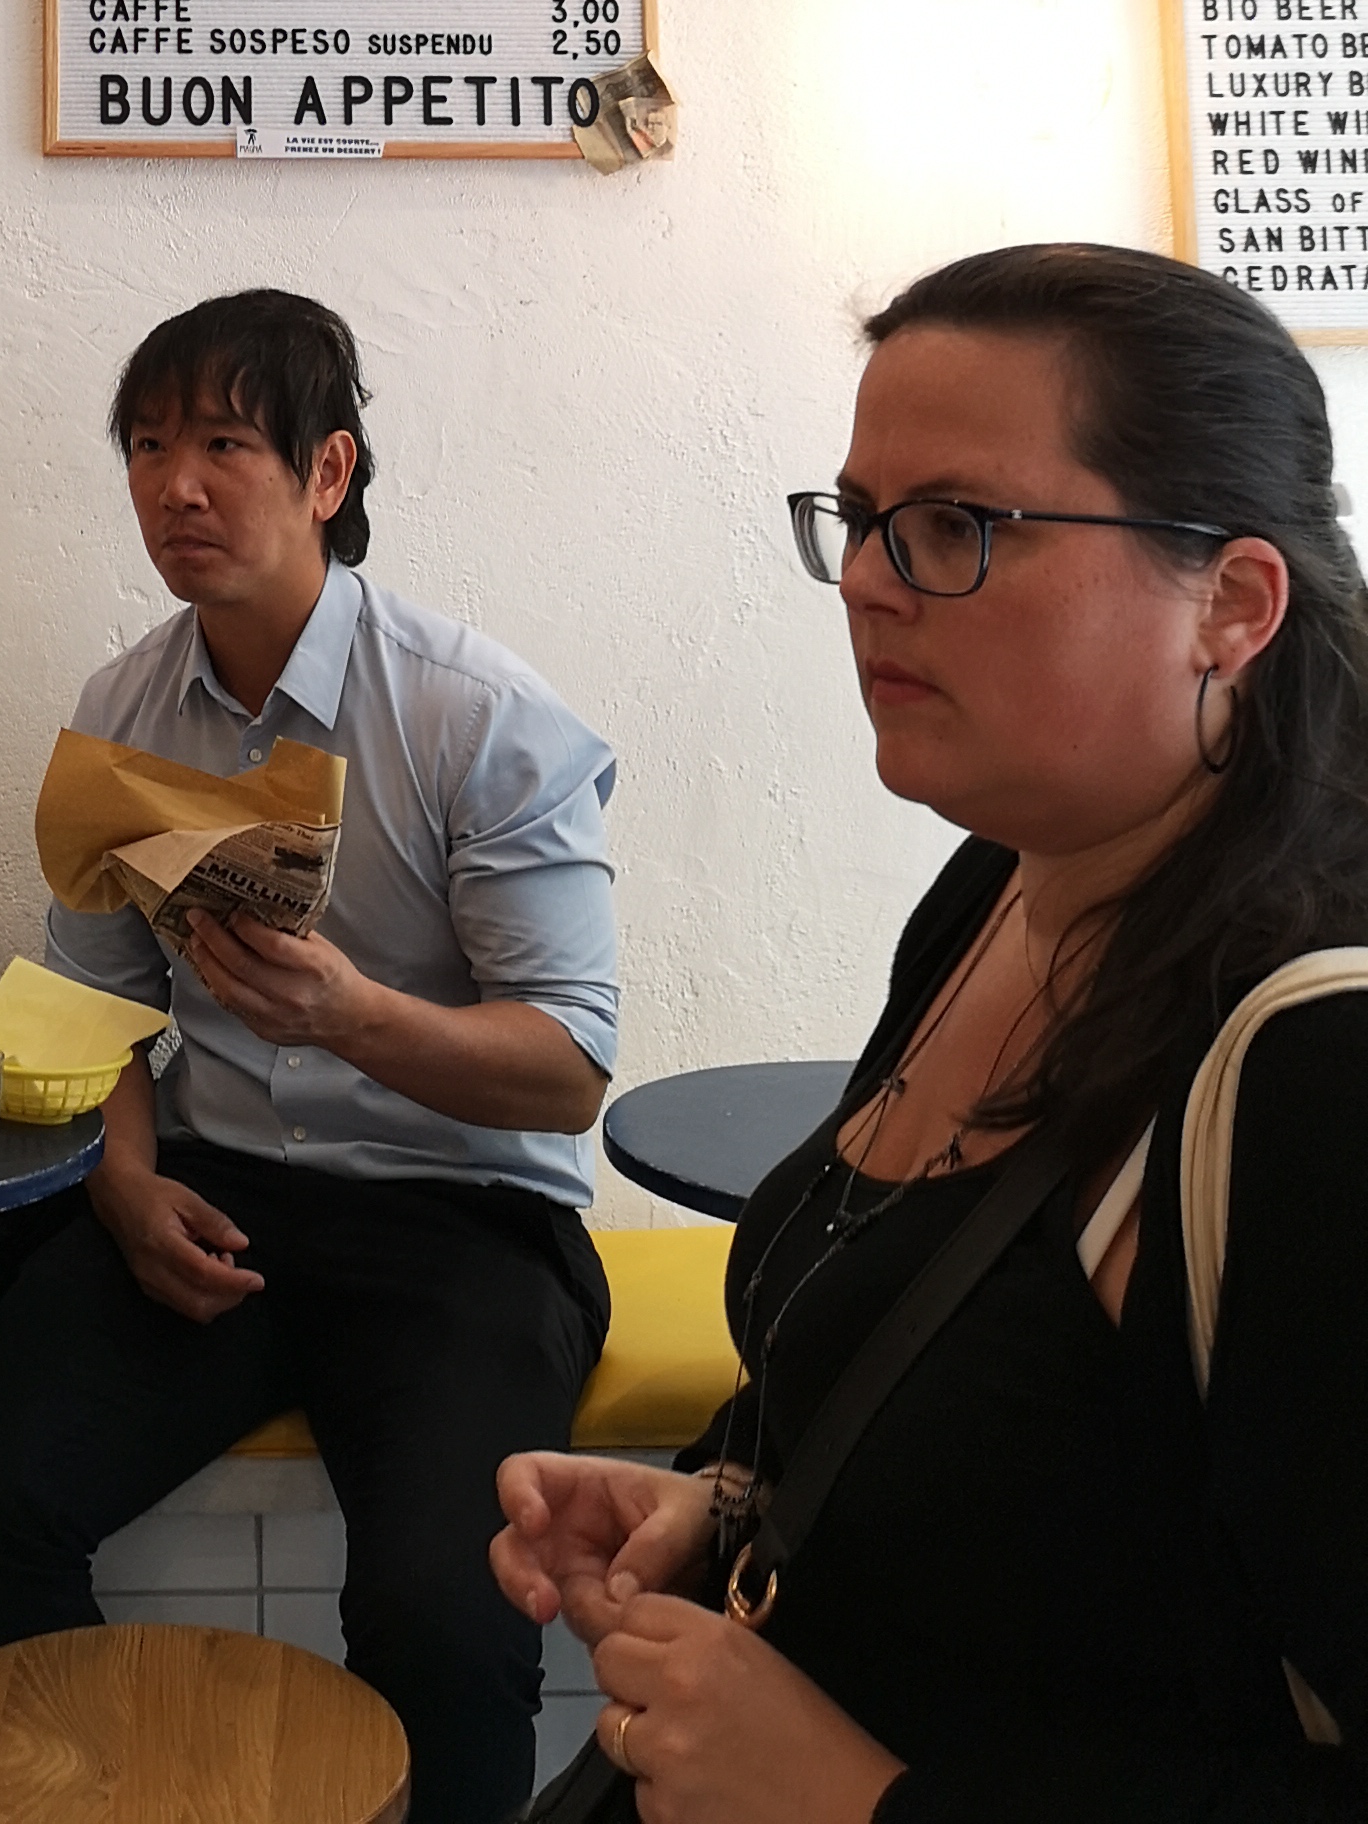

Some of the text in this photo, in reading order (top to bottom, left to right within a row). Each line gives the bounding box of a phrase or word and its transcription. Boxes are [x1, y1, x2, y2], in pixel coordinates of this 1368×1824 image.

[88, 26, 621, 61] CAFFE SOSPESO SUSPENDU 2,50
[1200, 33, 1329, 60] TOMATO
[1208, 71, 1333, 98] LUXURY
[98, 75, 601, 128] BUON APPETITO
[1207, 109, 1368, 137] WHITE WI
[337, 146, 375, 154] DESSERT
[1212, 148, 1280, 175] RED
[1213, 187, 1311, 214] GLASS
[1218, 226, 1284, 254] SAN
